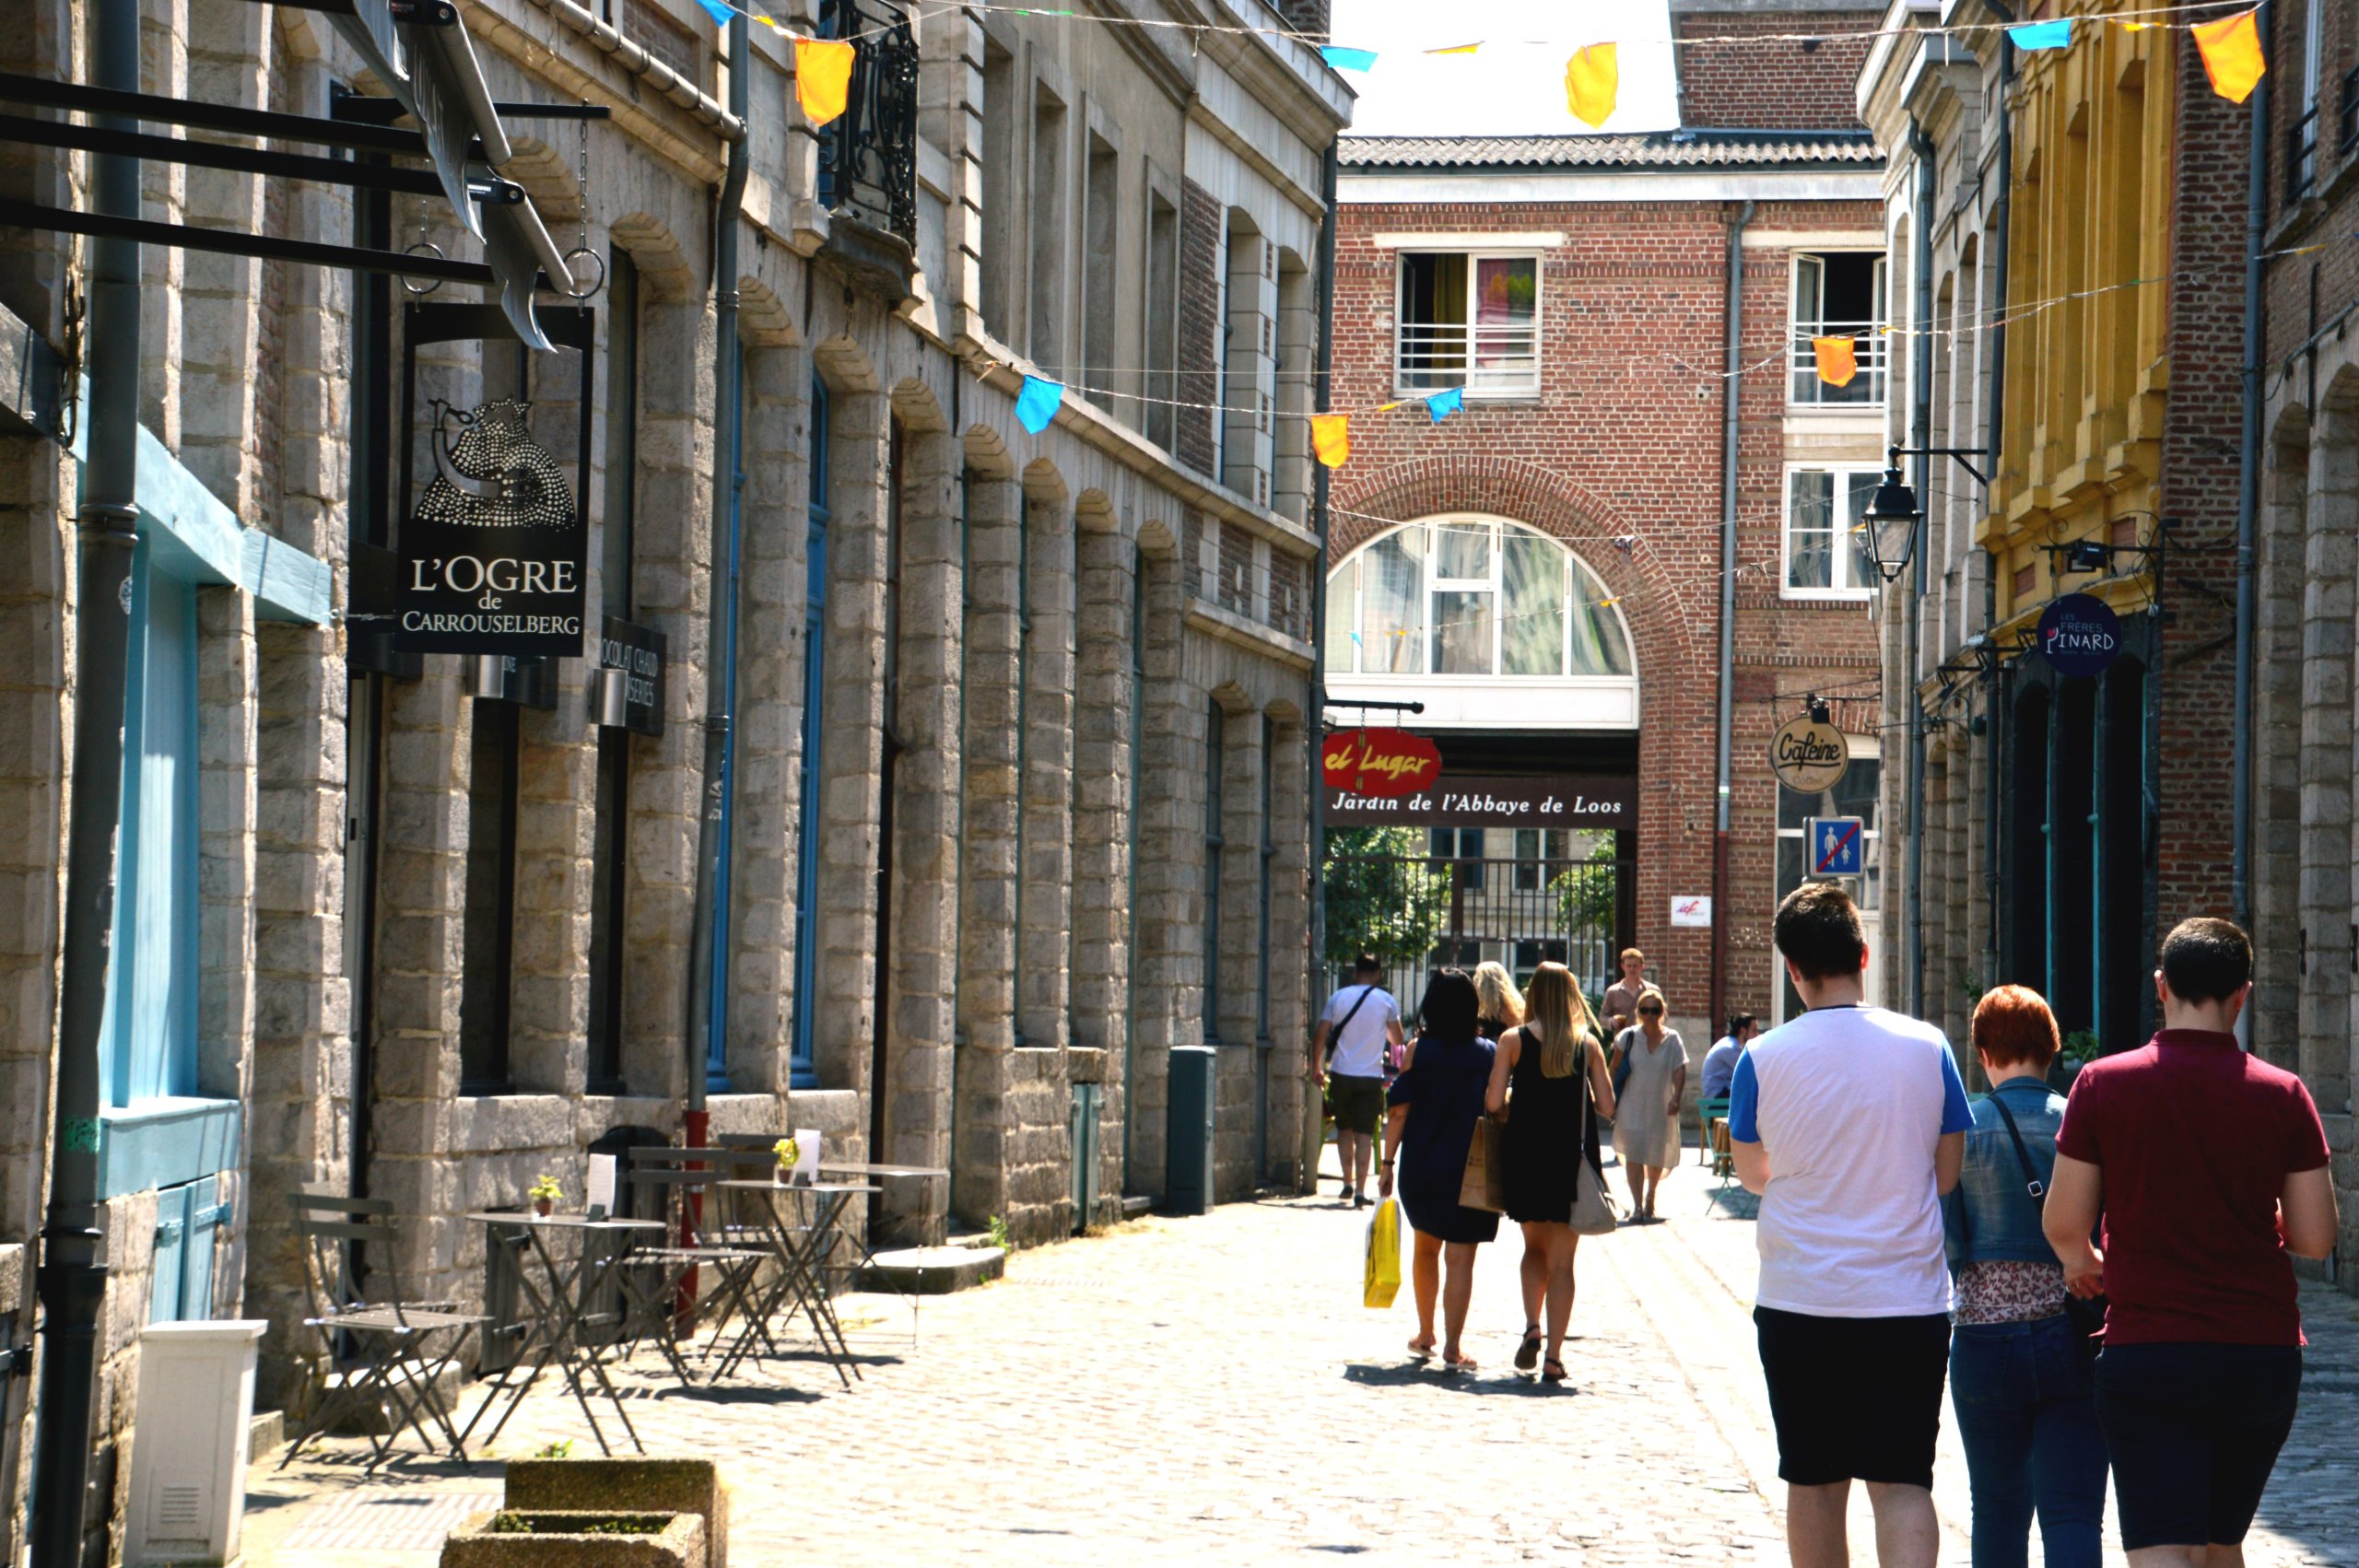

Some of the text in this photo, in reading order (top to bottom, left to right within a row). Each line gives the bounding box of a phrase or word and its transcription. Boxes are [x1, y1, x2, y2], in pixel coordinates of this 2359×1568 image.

[410, 556, 578, 594] L'OGRE
[478, 590, 502, 610] de
[403, 611, 580, 636] CARROUSELBERG
[2060, 613, 2075, 621] LES
[2046, 626, 2114, 654] PINARD
[602, 638, 632, 670] OCOLAT
[1325, 744, 1431, 780] el Lugar
[1332, 792, 1622, 816] Jardin de l'Abbaye de Loos
